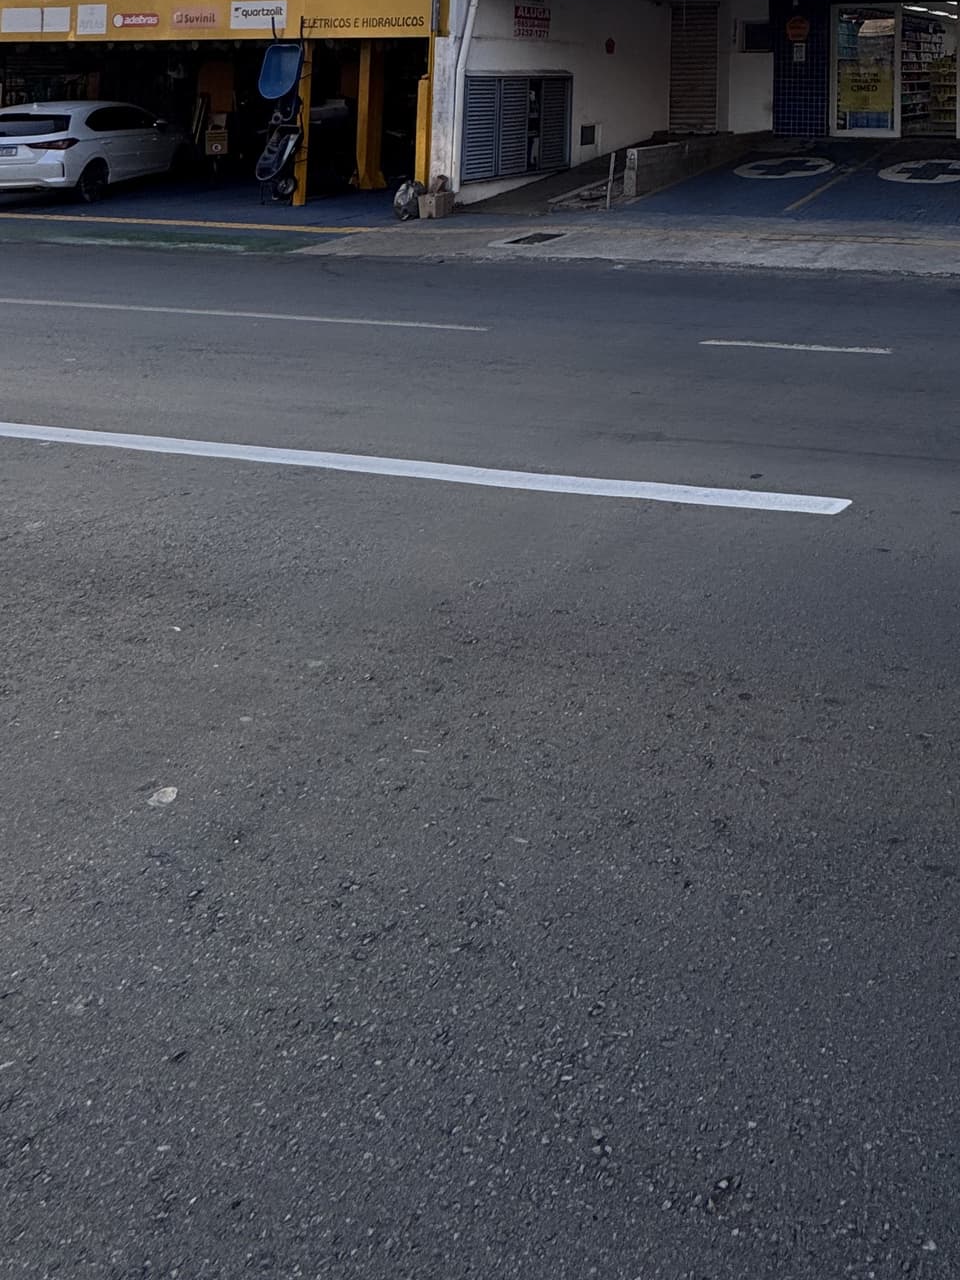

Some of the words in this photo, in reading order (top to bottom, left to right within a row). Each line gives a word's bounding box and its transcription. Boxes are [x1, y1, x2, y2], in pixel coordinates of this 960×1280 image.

[184, 12, 216, 24] Suvinil
[241, 6, 283, 18] quartzolit
[353, 18, 359, 28] E
